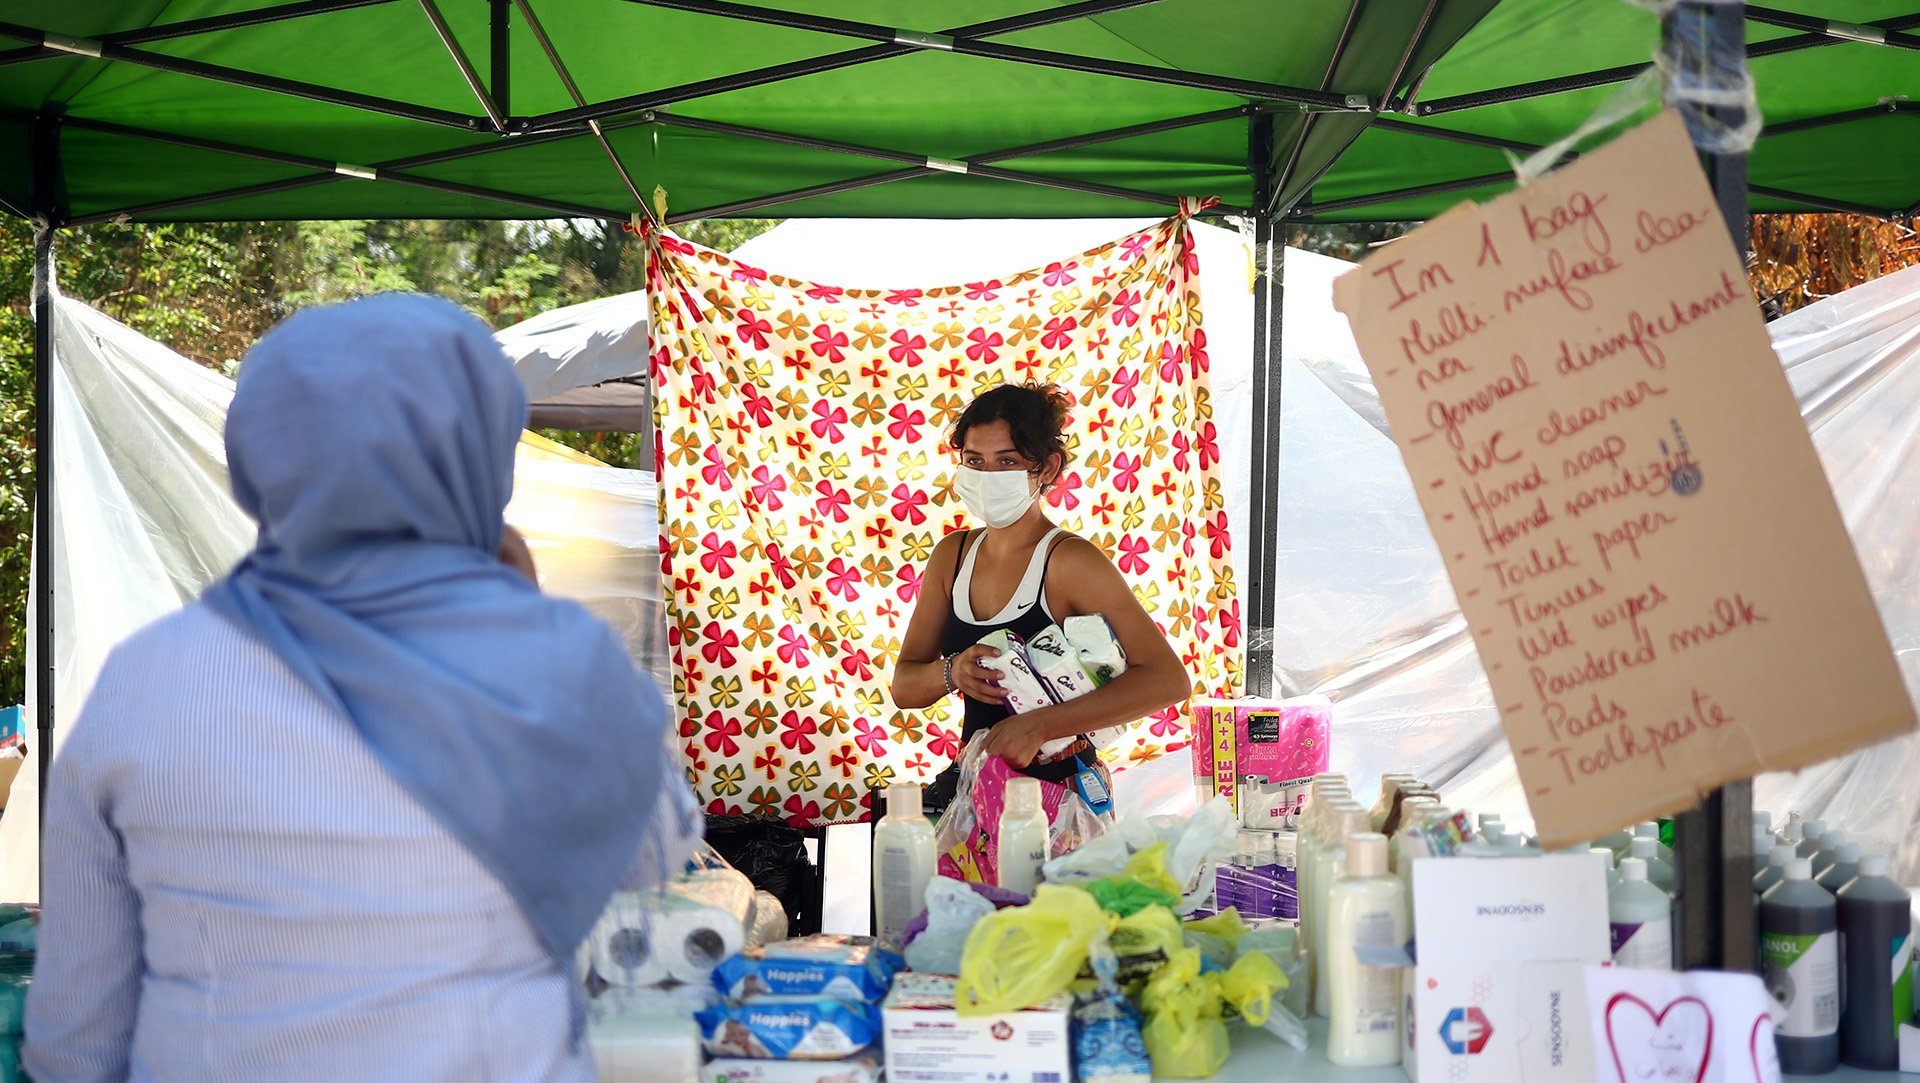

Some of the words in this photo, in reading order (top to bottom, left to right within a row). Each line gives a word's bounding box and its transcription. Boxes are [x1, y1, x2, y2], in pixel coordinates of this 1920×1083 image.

[1476, 222, 1502, 268] 1
[1520, 190, 1608, 257] bag
[1456, 431, 1524, 477] WC
[1536, 378, 1668, 446] cleaner
[1461, 464, 1550, 518] Hand
[1562, 435, 1627, 480] soap
[1478, 497, 1555, 554] Hand
[1486, 538, 1579, 589] Toilet
[1592, 510, 1678, 572] paper
[1517, 620, 1576, 662] Wet
[1592, 582, 1668, 644] wipes
[1529, 627, 1657, 701] Powdered
[1668, 592, 1770, 654] milk
[1214, 711, 1233, 724] 14
[1218, 726, 1228, 736] +
[1219, 739, 1229, 752] 4
[1540, 697, 1628, 742] Pads
[1548, 688, 1737, 784] Toothpaste
[1218, 760, 1234, 807] REE
[767, 968, 824, 983] Happies
[750, 1013, 811, 1029] Happies
